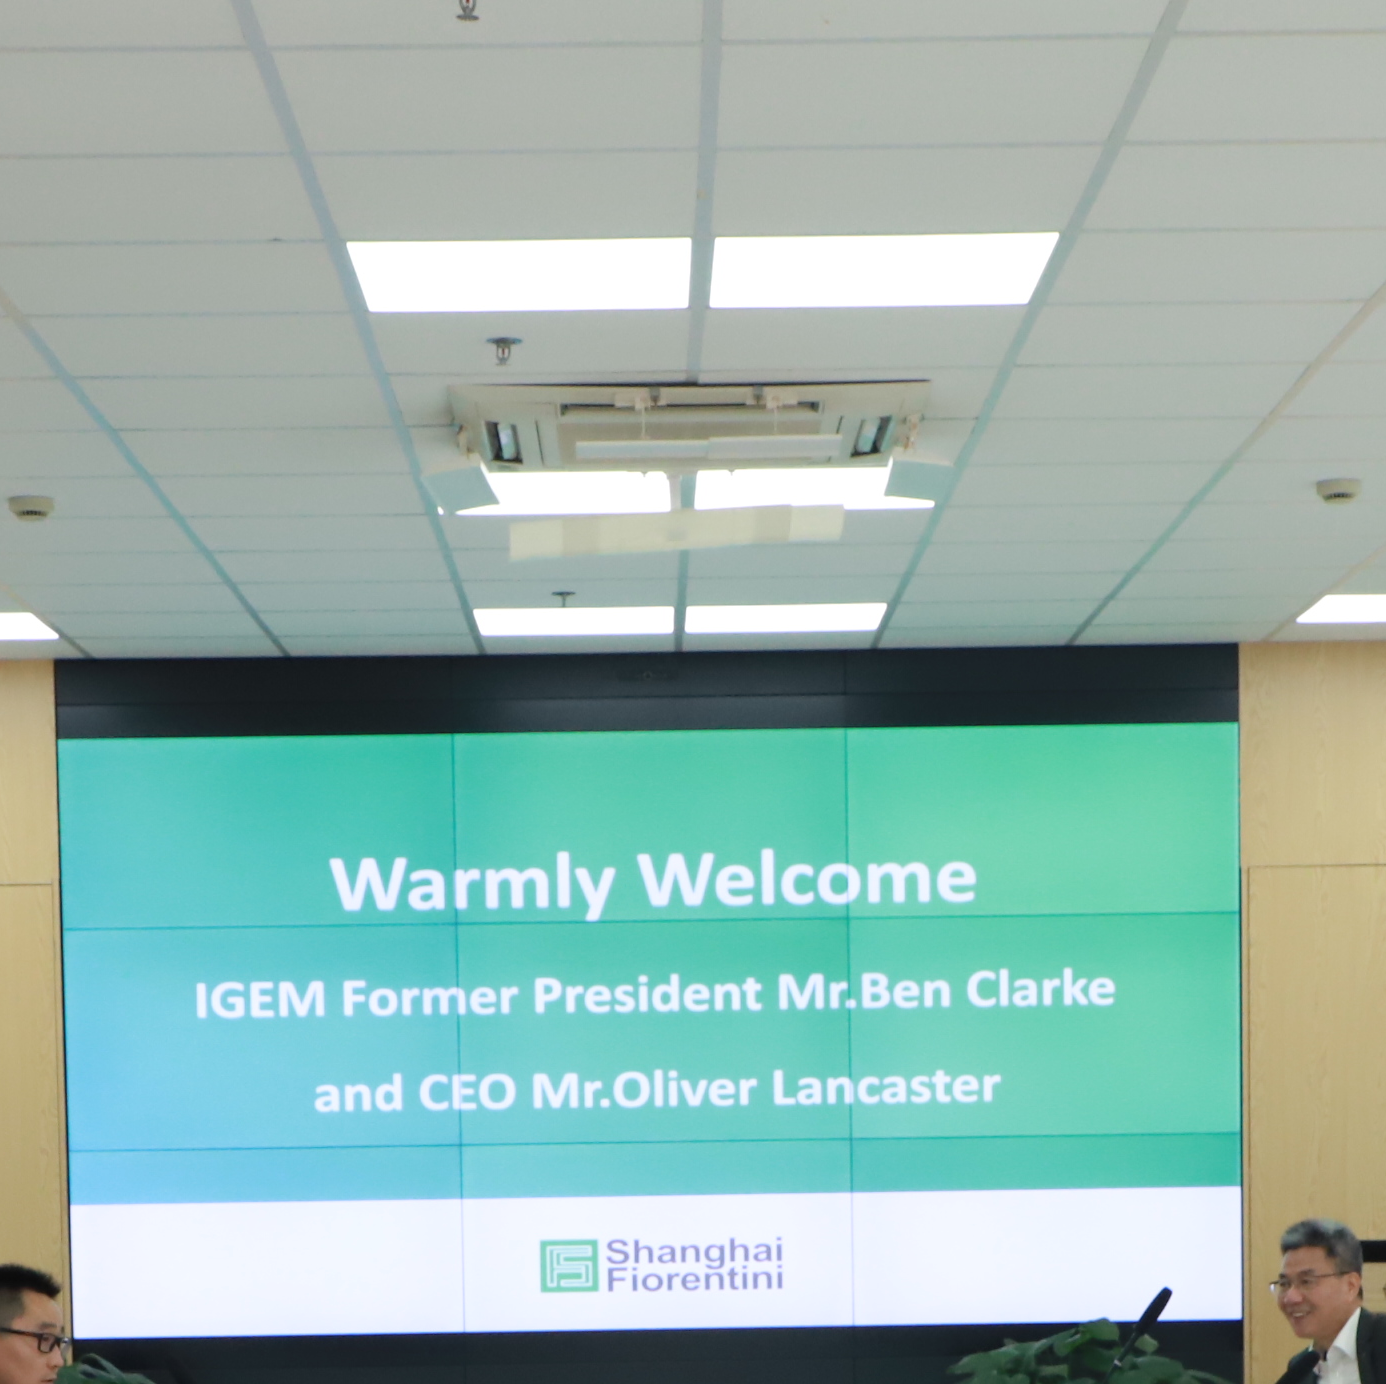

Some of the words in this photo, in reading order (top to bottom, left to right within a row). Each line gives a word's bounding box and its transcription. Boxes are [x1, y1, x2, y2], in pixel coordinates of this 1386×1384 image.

[328, 851, 616, 922] Warmly
[636, 848, 978, 907] Welcome
[195, 980, 325, 1018] IGEM
[342, 980, 519, 1016] Former
[533, 973, 762, 1014] President
[778, 971, 952, 1010] Mr.Ben
[966, 967, 1116, 1009] Clarke
[314, 1073, 403, 1112] and
[418, 1073, 517, 1111] CEO
[532, 1068, 758, 1109] Mr.Oliver
[772, 1069, 1002, 1106] Lancaster
[606, 1236, 784, 1270] Shanghai
[607, 1265, 784, 1293] Fiorentini
